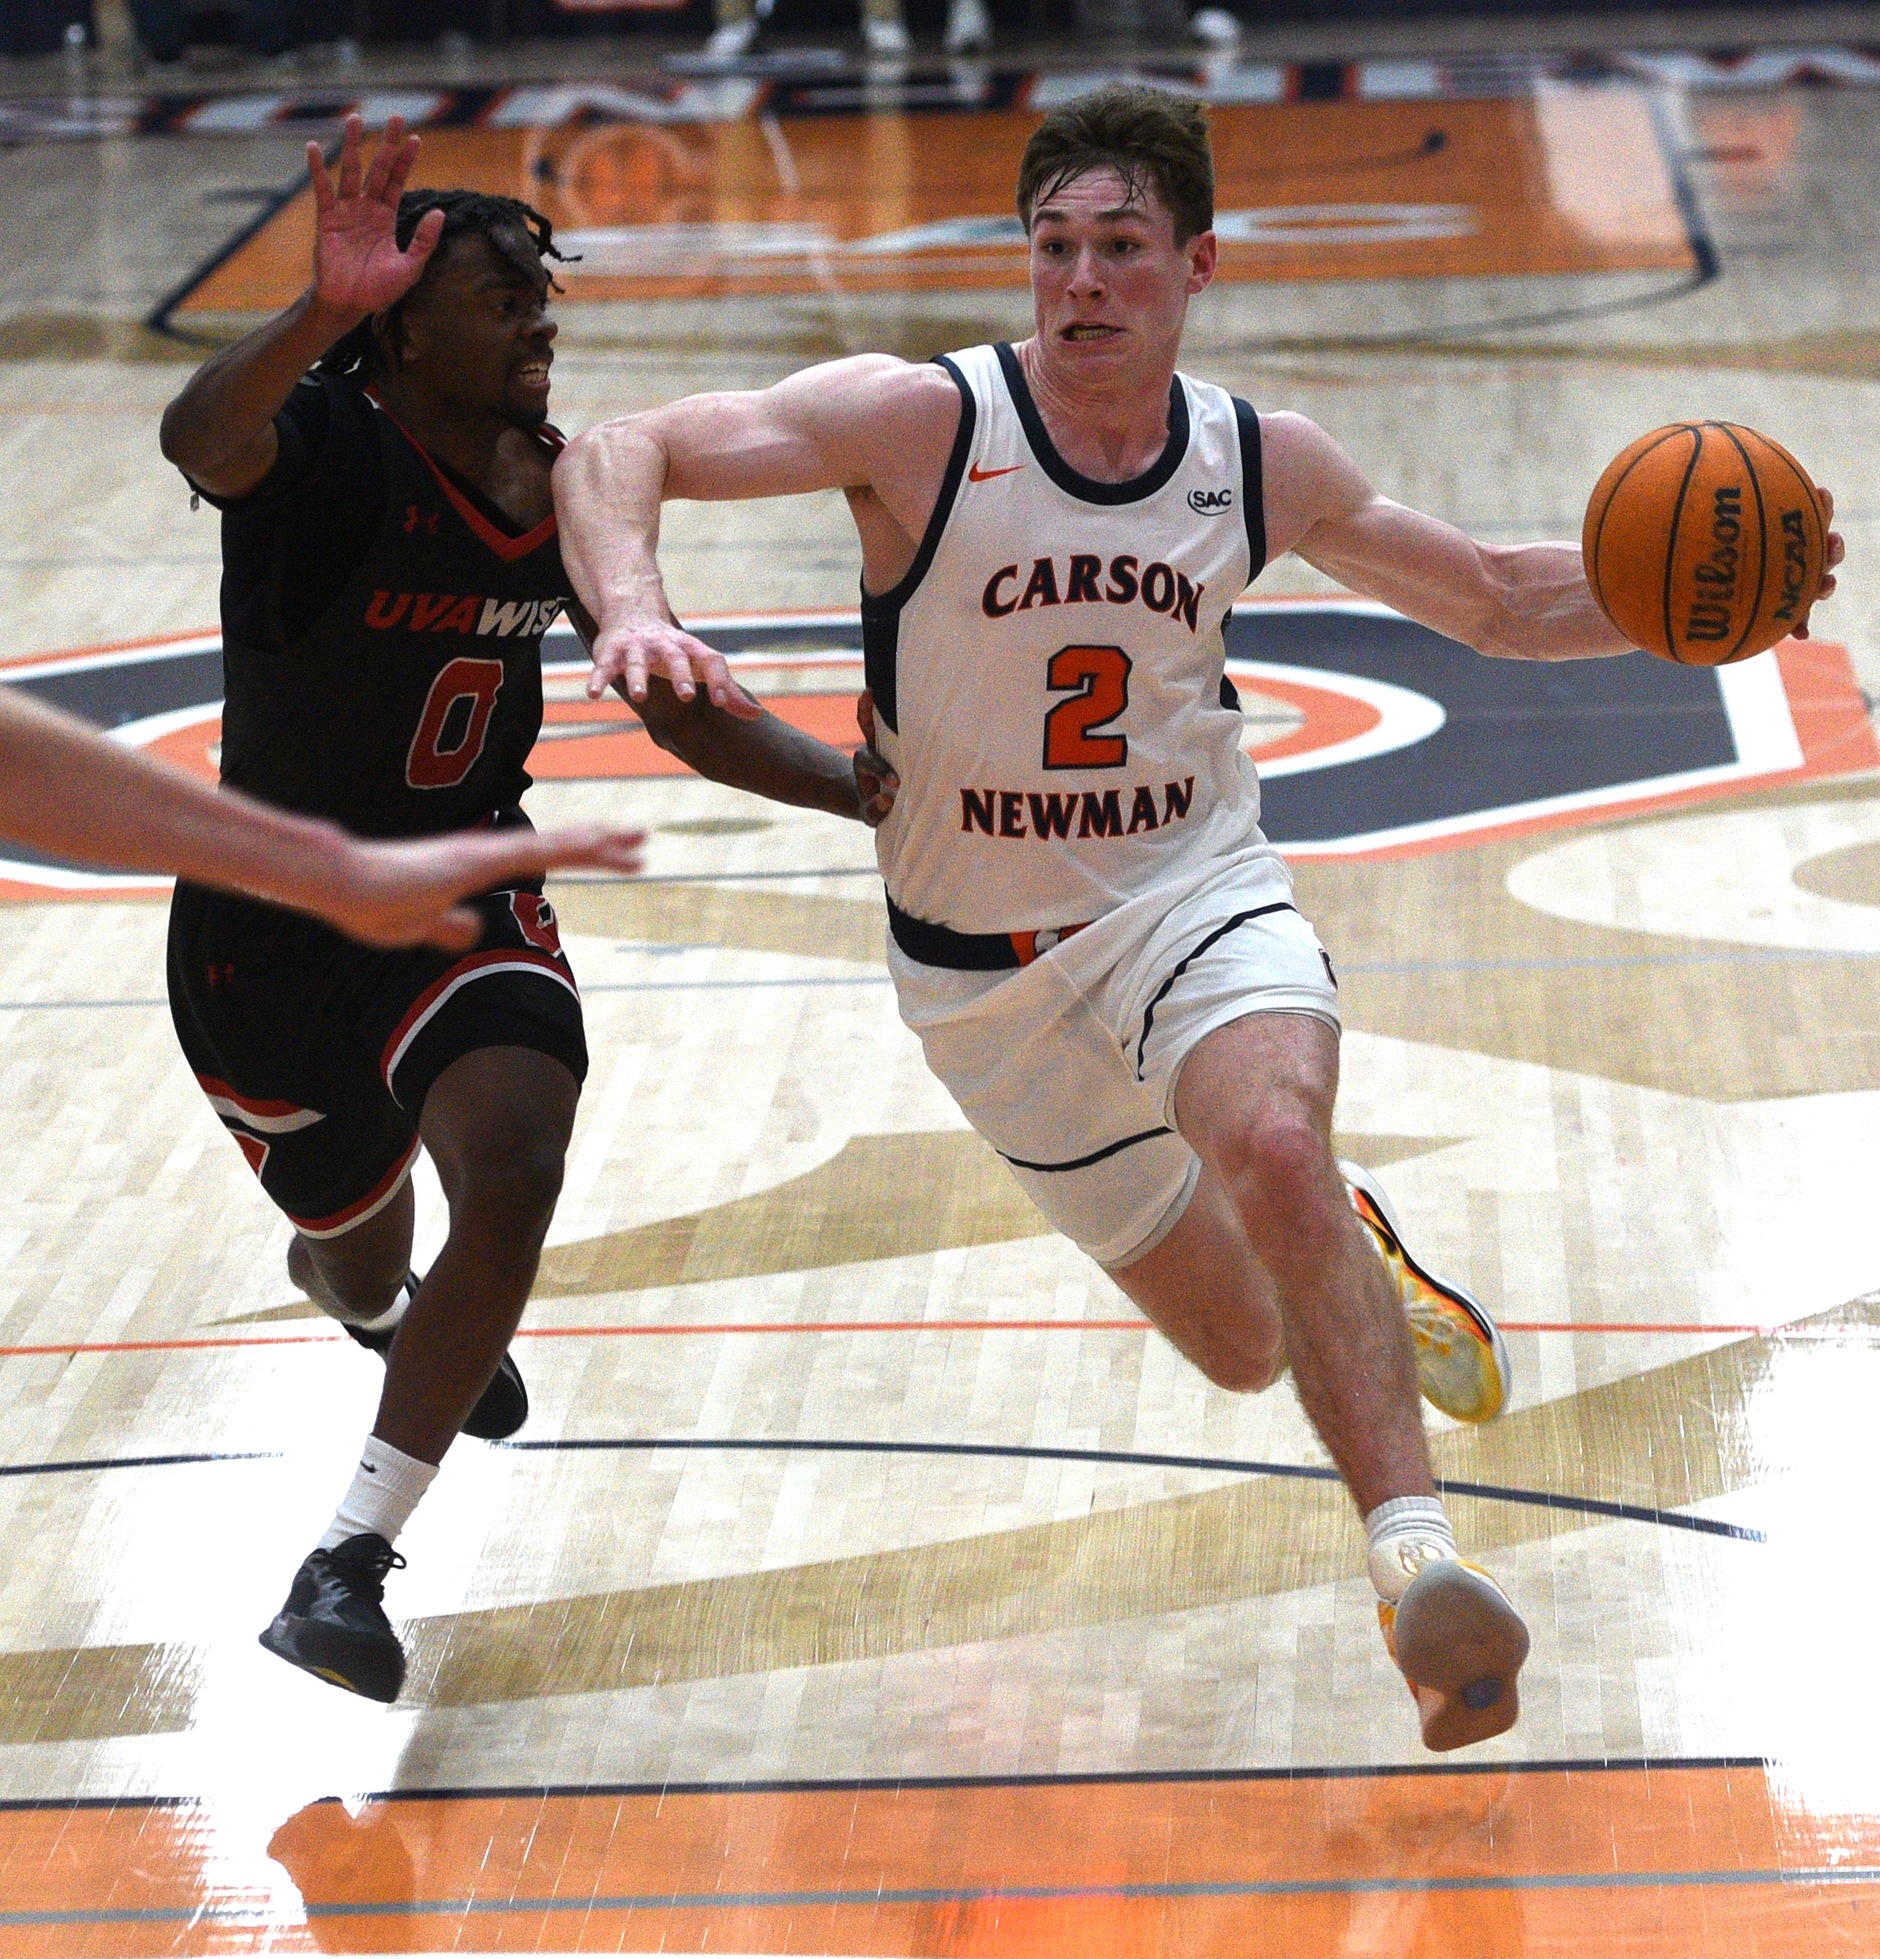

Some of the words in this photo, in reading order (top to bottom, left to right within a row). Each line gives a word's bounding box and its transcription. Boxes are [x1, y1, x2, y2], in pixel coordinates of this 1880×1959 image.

[1193, 488, 1232, 509] SAC
[982, 553, 1205, 635] CARSON
[1685, 486, 1742, 641] Wilson
[1772, 509, 1807, 621] NCAA
[364, 589, 571, 637] UVAWIS
[405, 656, 504, 790] 0
[1042, 644, 1133, 771] 2
[960, 775, 1195, 841] NEWMAN
